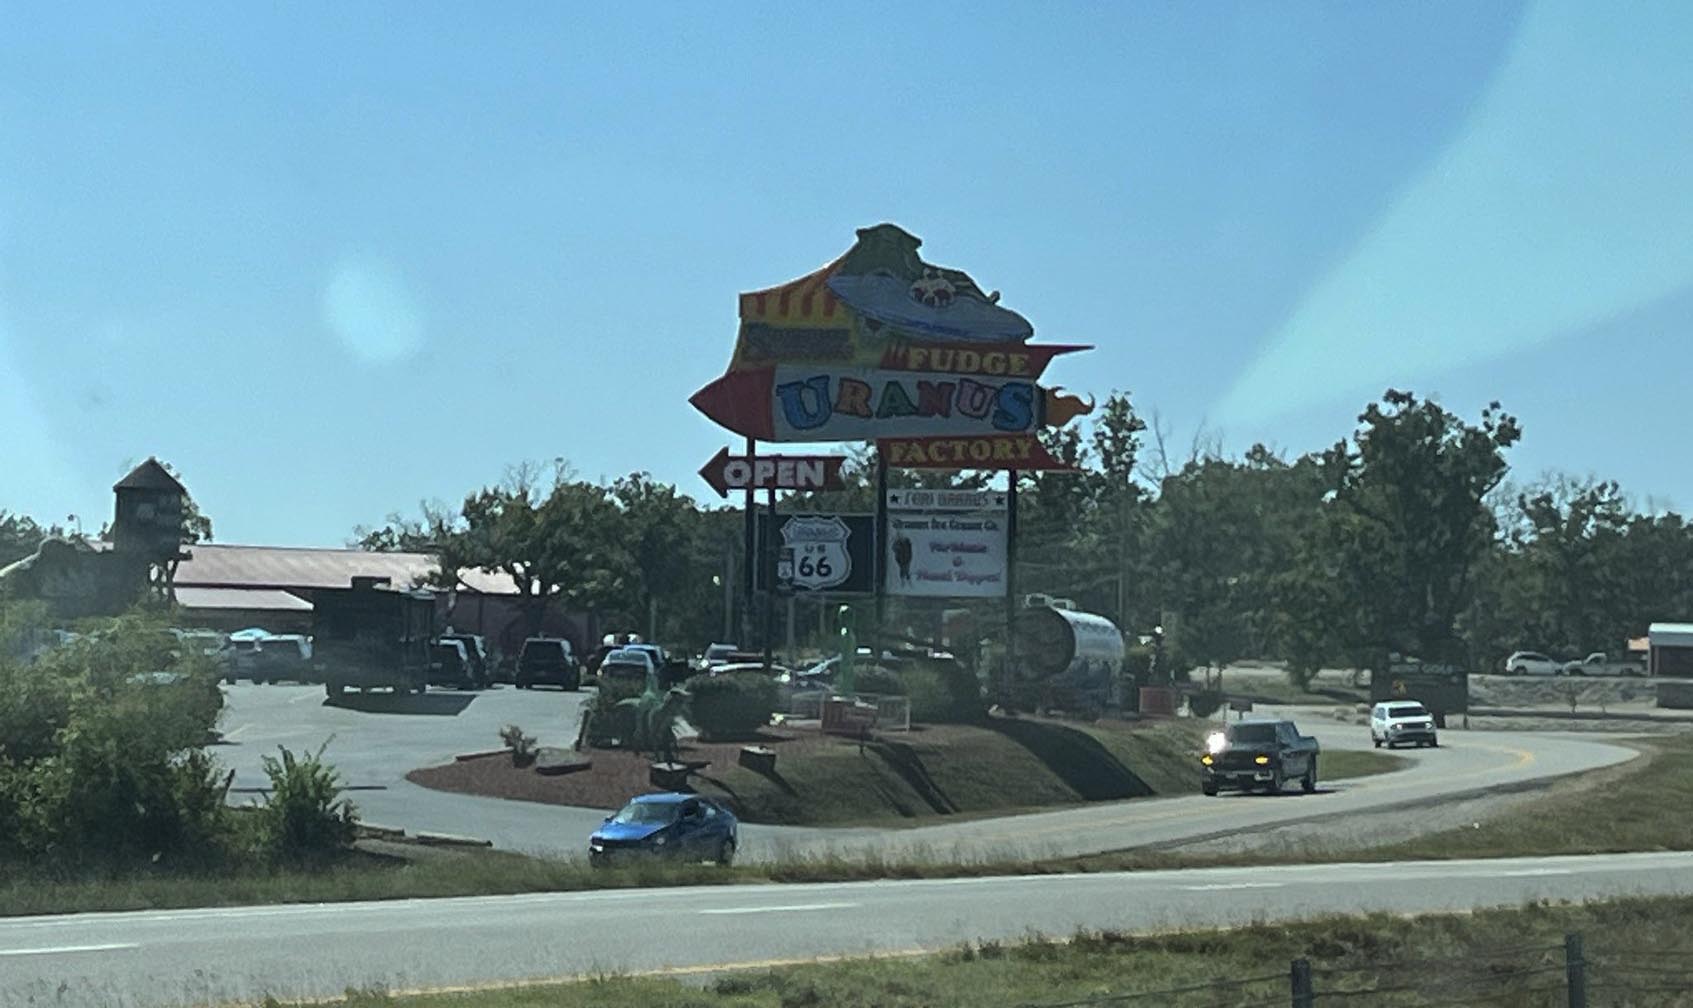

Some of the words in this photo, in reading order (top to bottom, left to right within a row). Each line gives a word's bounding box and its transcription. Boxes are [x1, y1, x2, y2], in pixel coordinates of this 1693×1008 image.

[907, 348, 1030, 375] FUDGE
[776, 375, 1035, 431] URANUS
[888, 438, 1034, 463] FACTORY
[723, 460, 825, 488] OPEN
[799, 556, 832, 577] 66
